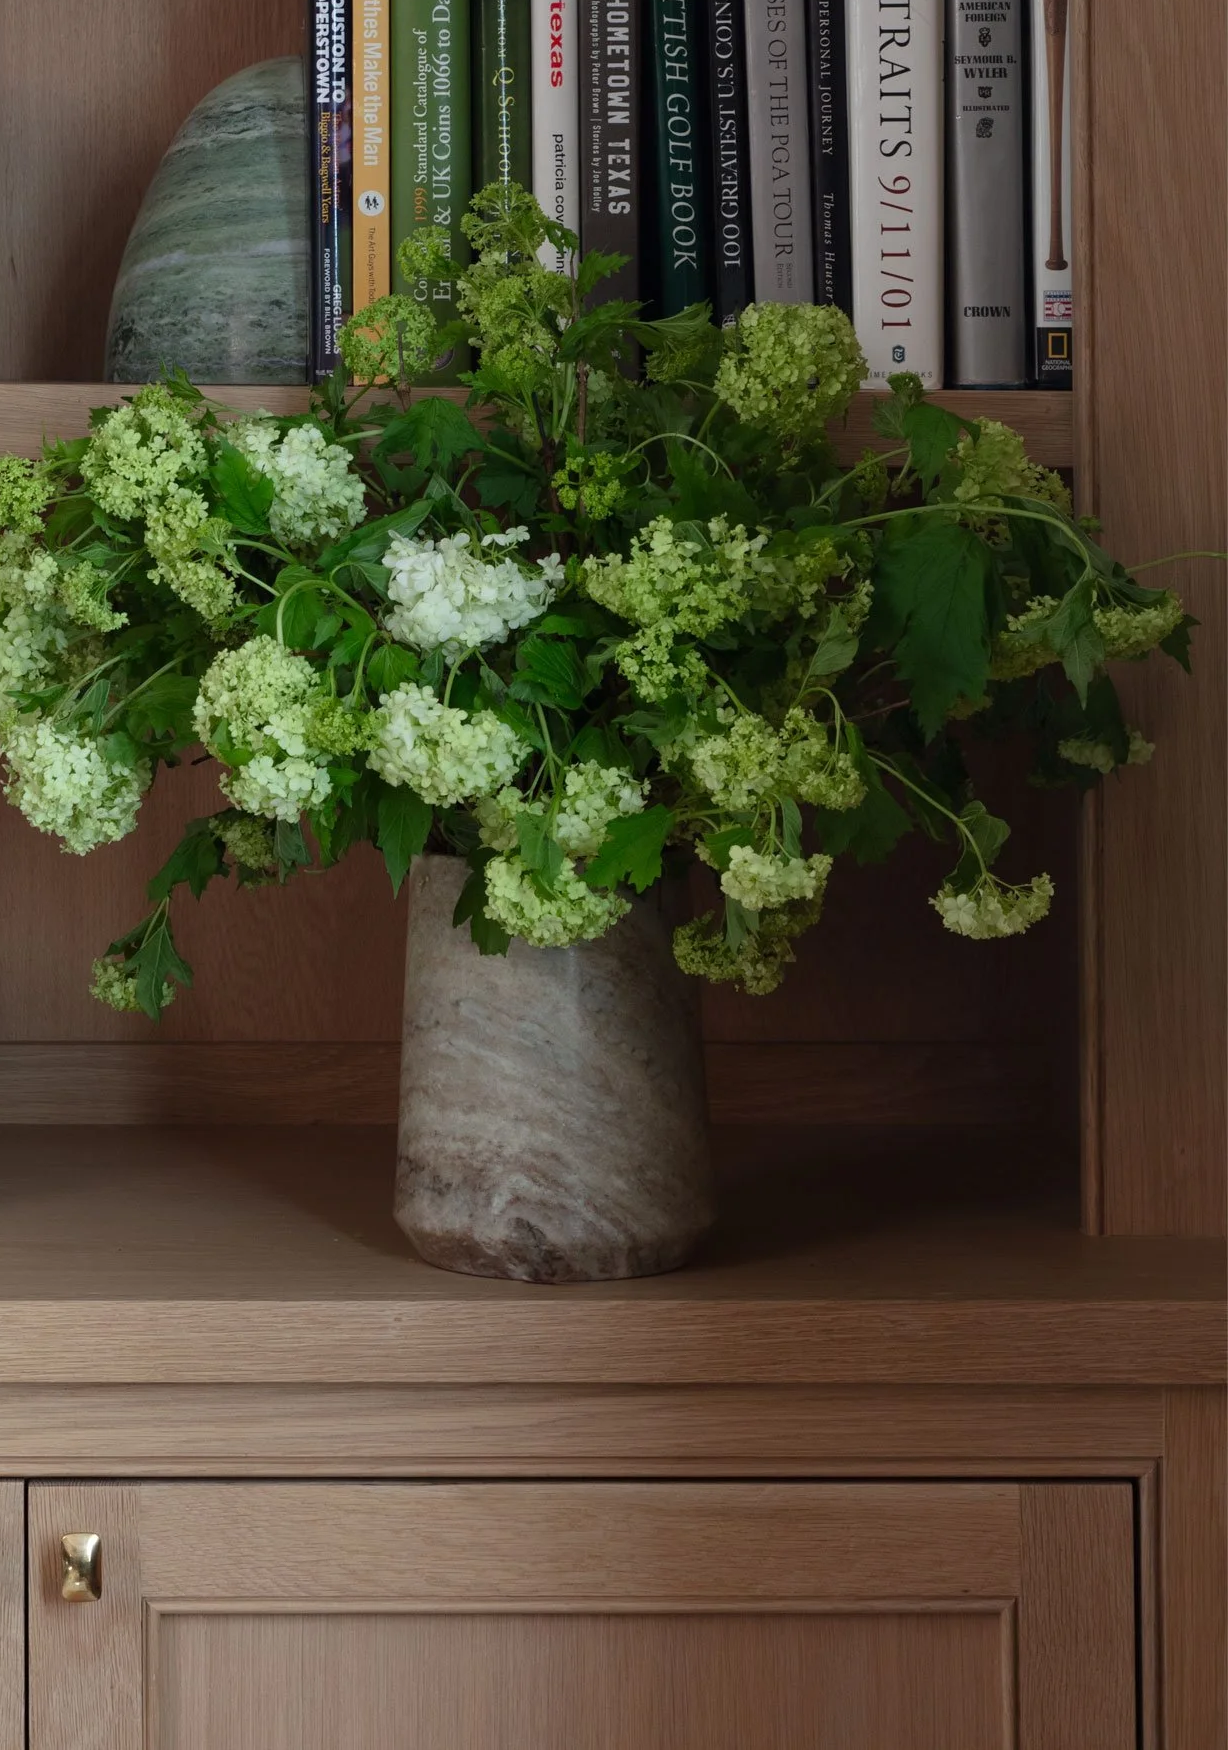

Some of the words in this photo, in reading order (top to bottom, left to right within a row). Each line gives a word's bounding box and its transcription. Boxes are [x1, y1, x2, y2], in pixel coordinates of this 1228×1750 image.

[958, 1, 1011, 11] AMERICAN
[965, 13, 1007, 22] FOREIGN
[413, 28, 427, 44] of
[435, 28, 451, 47] to
[550, 0, 565, 88] texas
[767, 39, 788, 70] OF
[818, 1, 832, 78] PERSONAL
[363, 43, 382, 92] Make
[413, 47, 431, 118] Catalogue
[432, 53, 451, 98] 1066
[718, 62, 736, 98] U.S.
[954, 55, 1003, 65] SEYMOUR
[1006, 55, 1017, 64] B.
[963, 68, 1008, 79] WYLER
[332, 77, 346, 104] TO
[363, 95, 382, 124] the
[769, 76, 789, 127] THE
[432, 105, 451, 160] Coins
[666, 93, 693, 173] GOLF
[819, 84, 833, 156] JOURNEY
[363, 127, 383, 166] Man
[413, 121, 427, 184] Standard
[719, 105, 740, 219] GREATEST
[772, 134, 790, 182] PGA
[432, 164, 451, 199] UK
[607, 138, 631, 215] TEXAS
[413, 187, 427, 221] 1999
[432, 205, 451, 225] &
[670, 182, 697, 270] BOOK
[774, 188, 794, 258] TOUR
[823, 193, 835, 245] Thomas
[722, 224, 741, 268] 100
[877, 175, 914, 330] 9/11/01
[824, 251, 836, 300] Hauser
[963, 306, 1011, 318] CROWN
